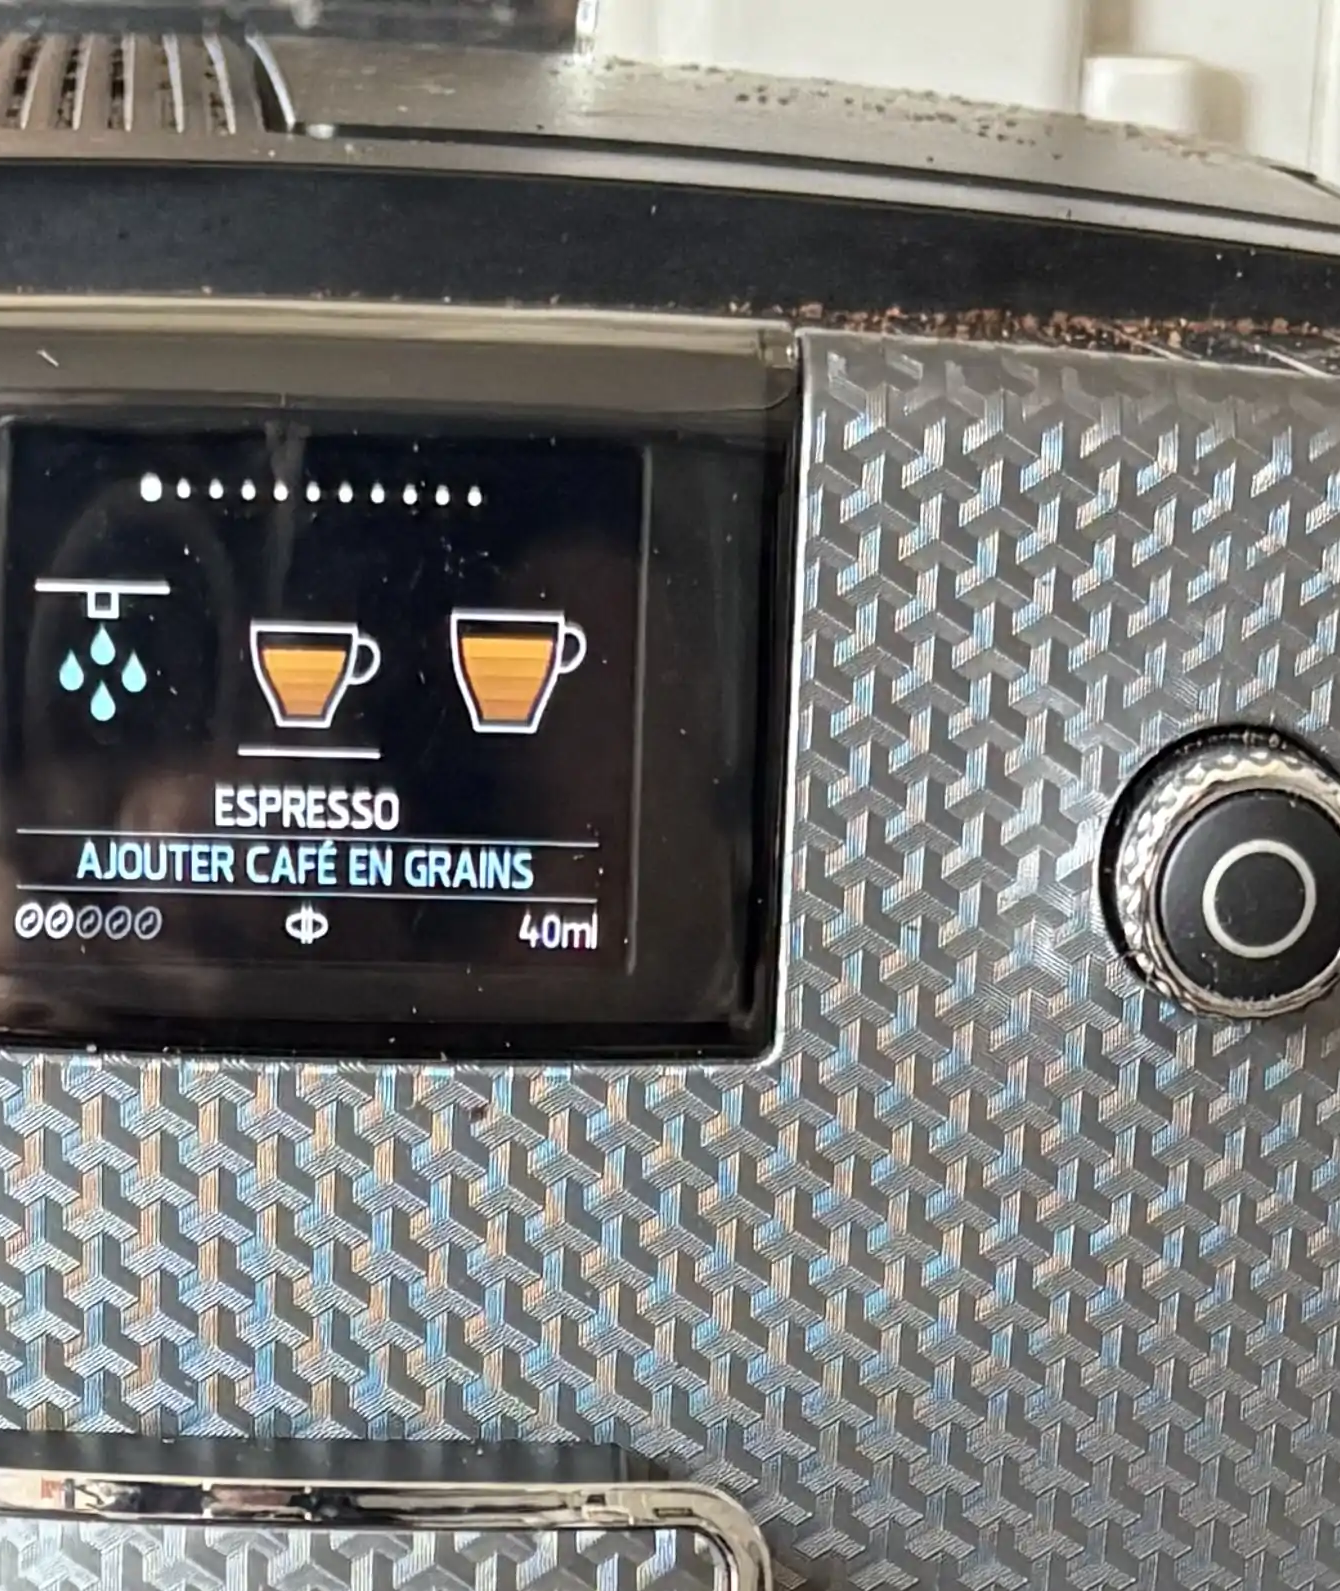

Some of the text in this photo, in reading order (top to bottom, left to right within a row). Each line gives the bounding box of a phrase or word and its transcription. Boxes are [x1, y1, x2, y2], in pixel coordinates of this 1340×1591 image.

[213, 784, 400, 831] ESPRESSO
[76, 840, 534, 890] AJOUTER CAFÉ EN GRAINS
[518, 912, 598, 950] 40ml
